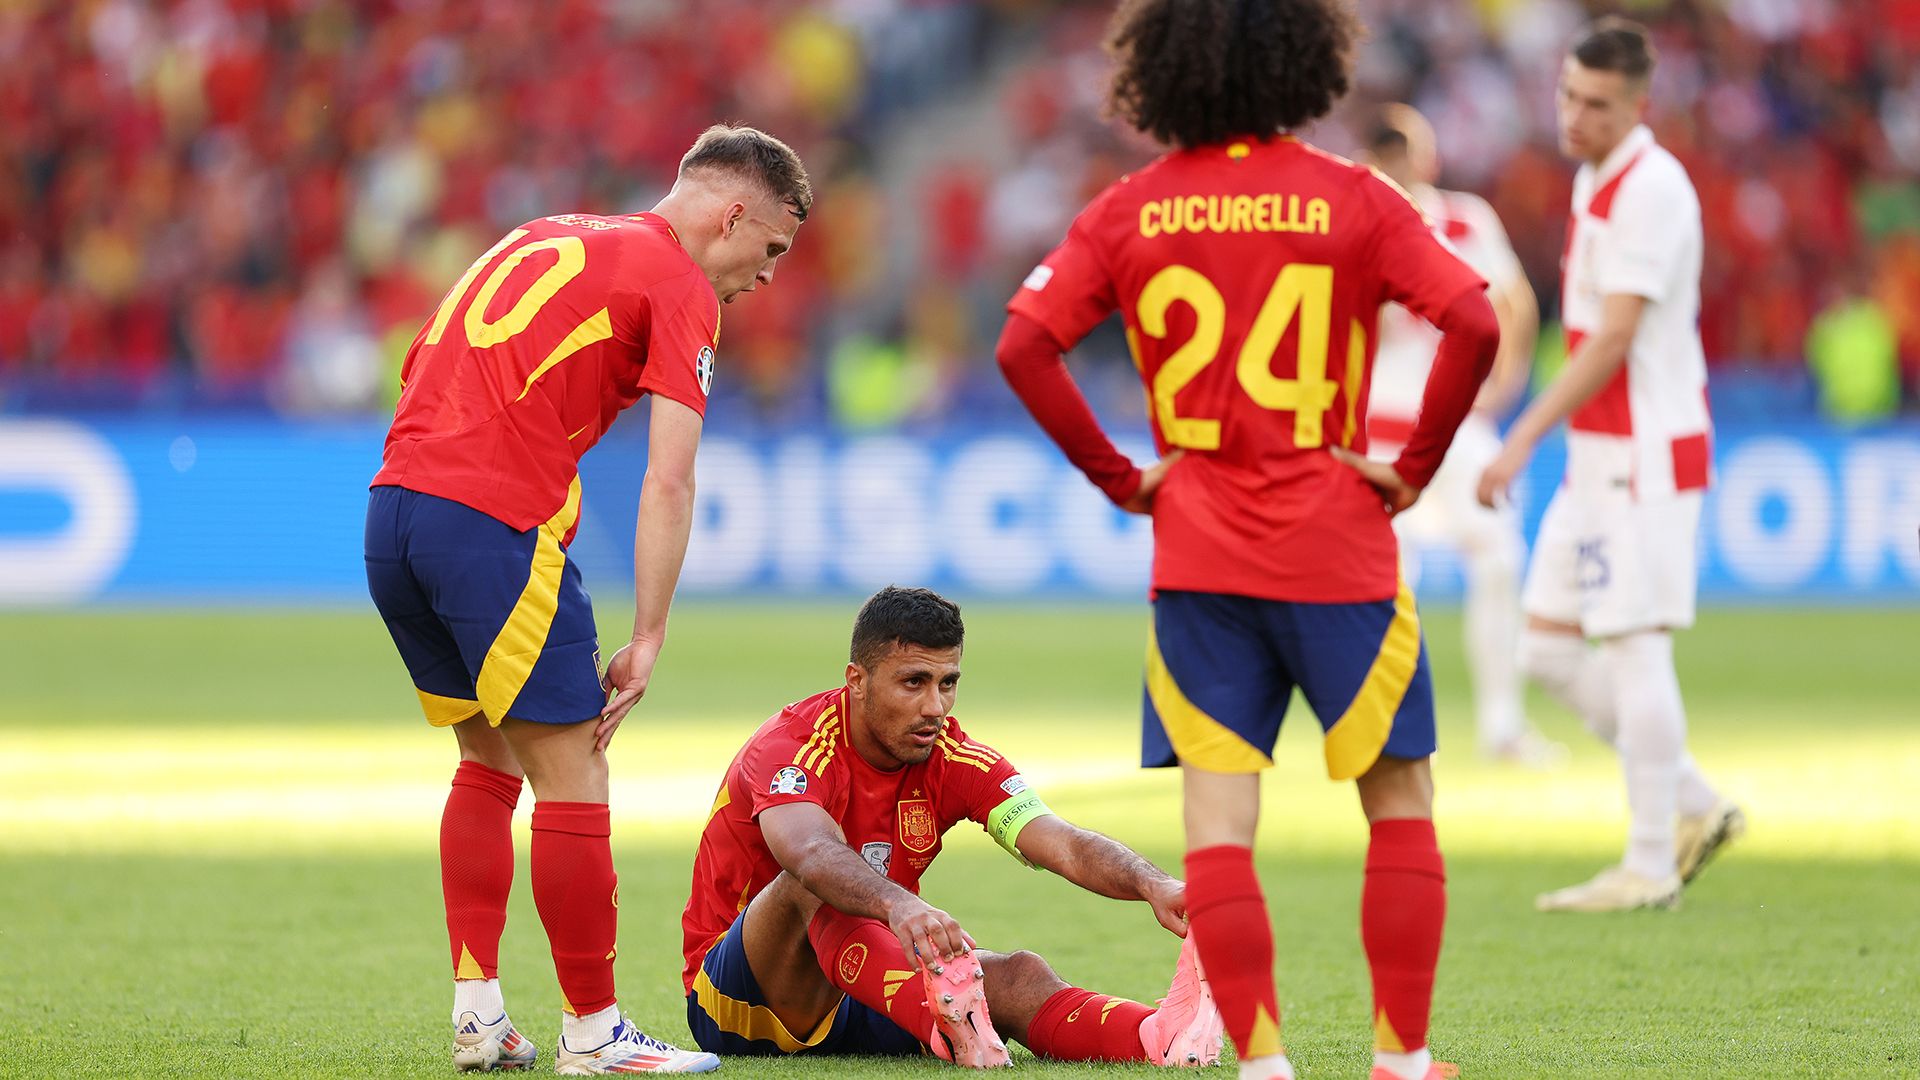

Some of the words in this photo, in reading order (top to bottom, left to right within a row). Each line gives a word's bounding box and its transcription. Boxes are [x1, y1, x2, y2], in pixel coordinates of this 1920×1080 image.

[1139, 194, 1331, 238] CUCURELLA
[425, 228, 587, 349] 10
[1136, 263, 1341, 450] 24
[1002, 798, 1041, 828] RESPEC
